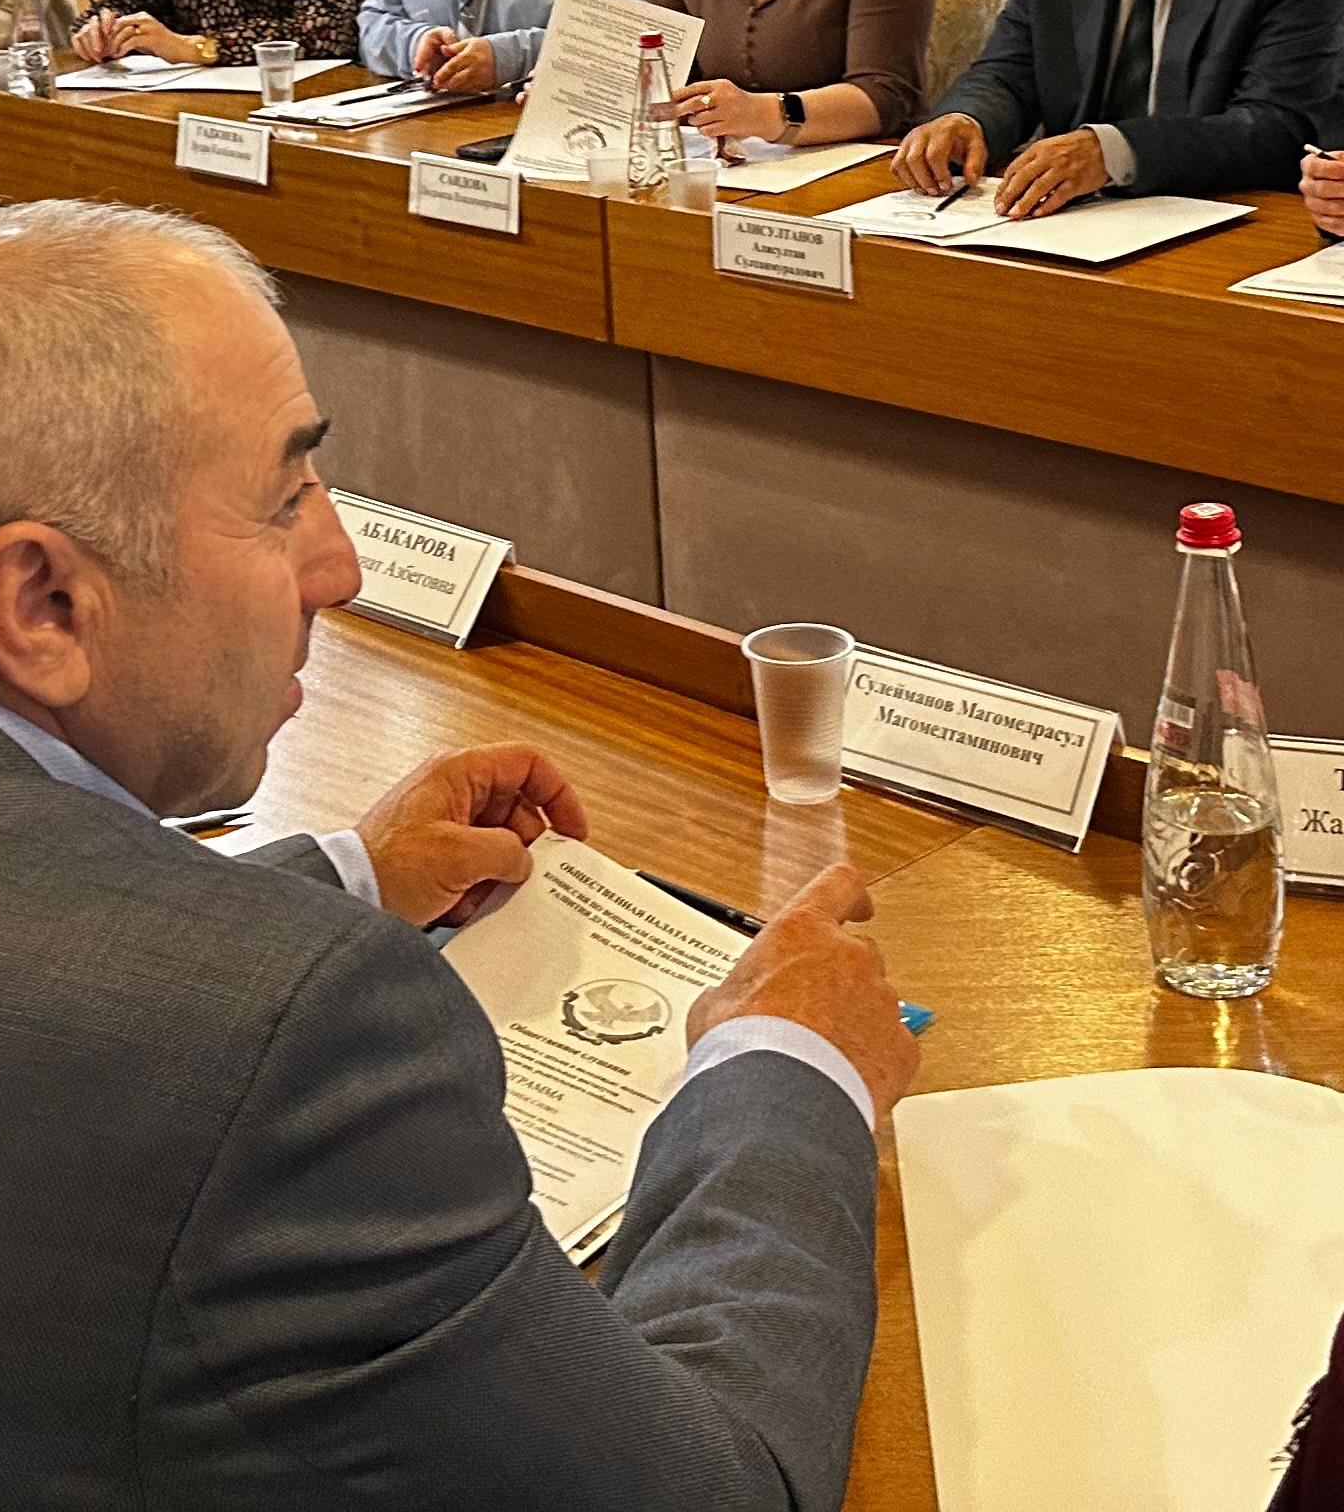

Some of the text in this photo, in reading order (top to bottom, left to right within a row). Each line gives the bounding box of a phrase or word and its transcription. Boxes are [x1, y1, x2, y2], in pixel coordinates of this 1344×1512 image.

[356, 520, 457, 563] АБАКАРОВА
[854, 672, 1085, 748] Сулейманов Магомедрасул
[559, 861, 646, 919] ОБЩЕСТВЕННАЯ
[644, 914, 688, 943] ПАЛАТА
